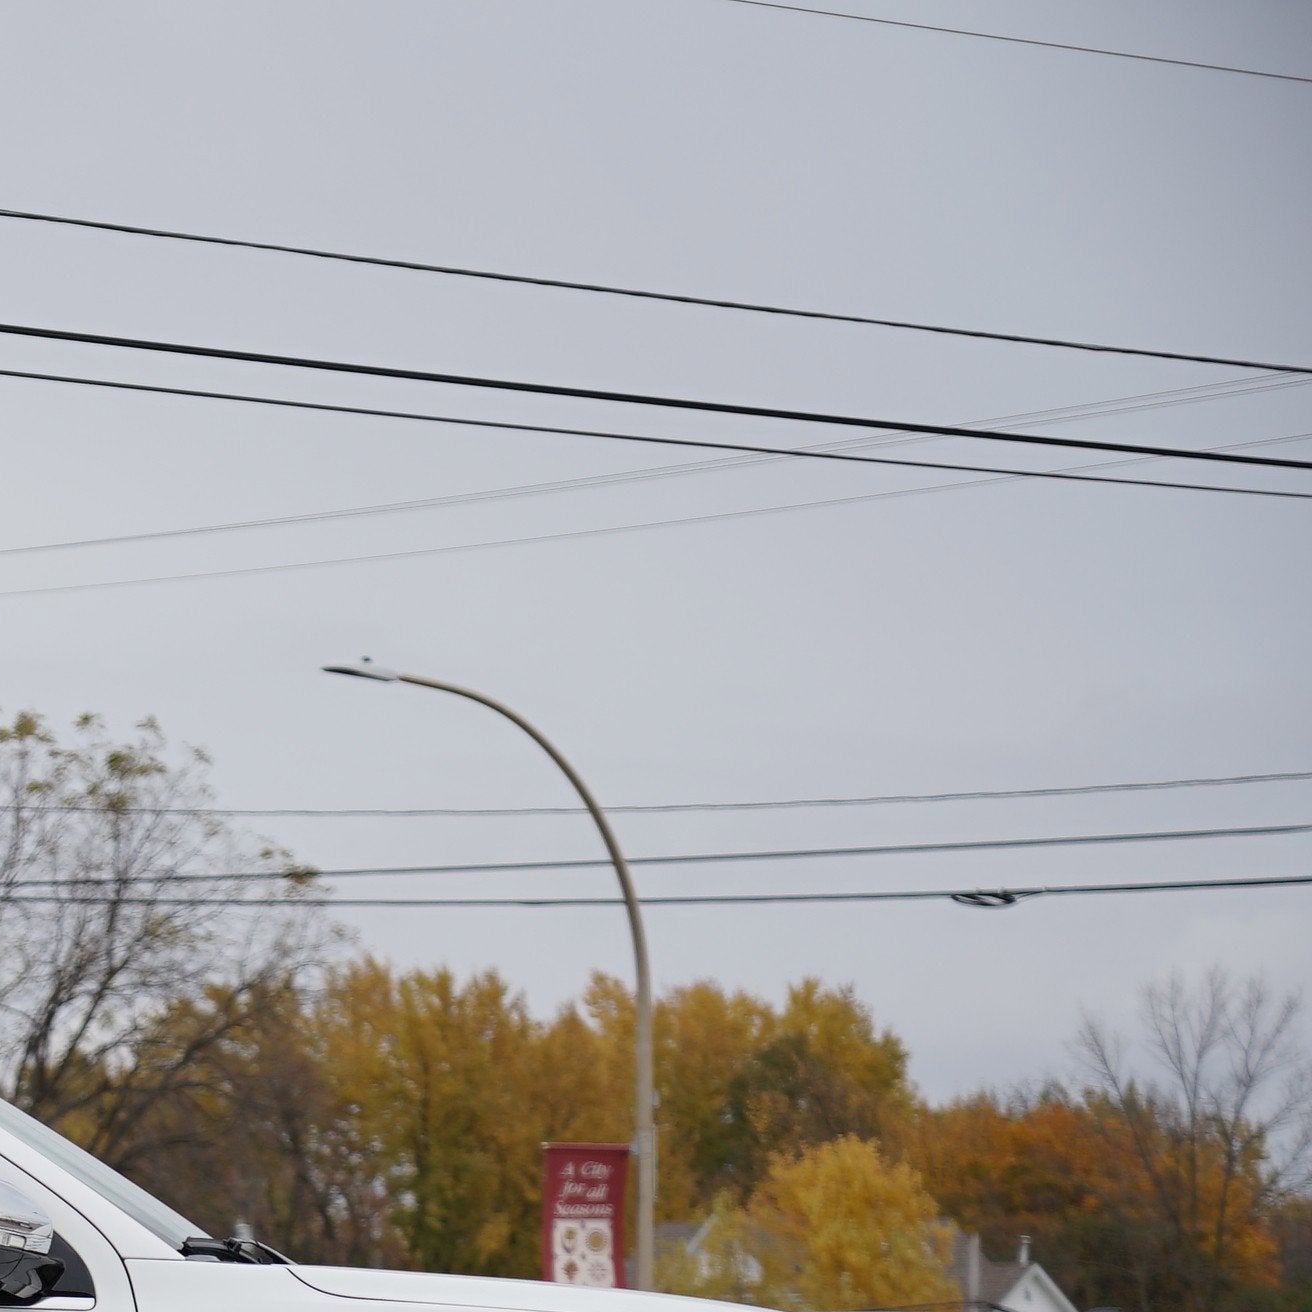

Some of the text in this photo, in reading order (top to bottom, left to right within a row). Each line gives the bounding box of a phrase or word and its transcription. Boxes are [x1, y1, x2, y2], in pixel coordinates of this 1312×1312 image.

[561, 1160, 614, 1179] A City
[558, 1180, 608, 1199] for all
[553, 1200, 614, 1215] Seasons
